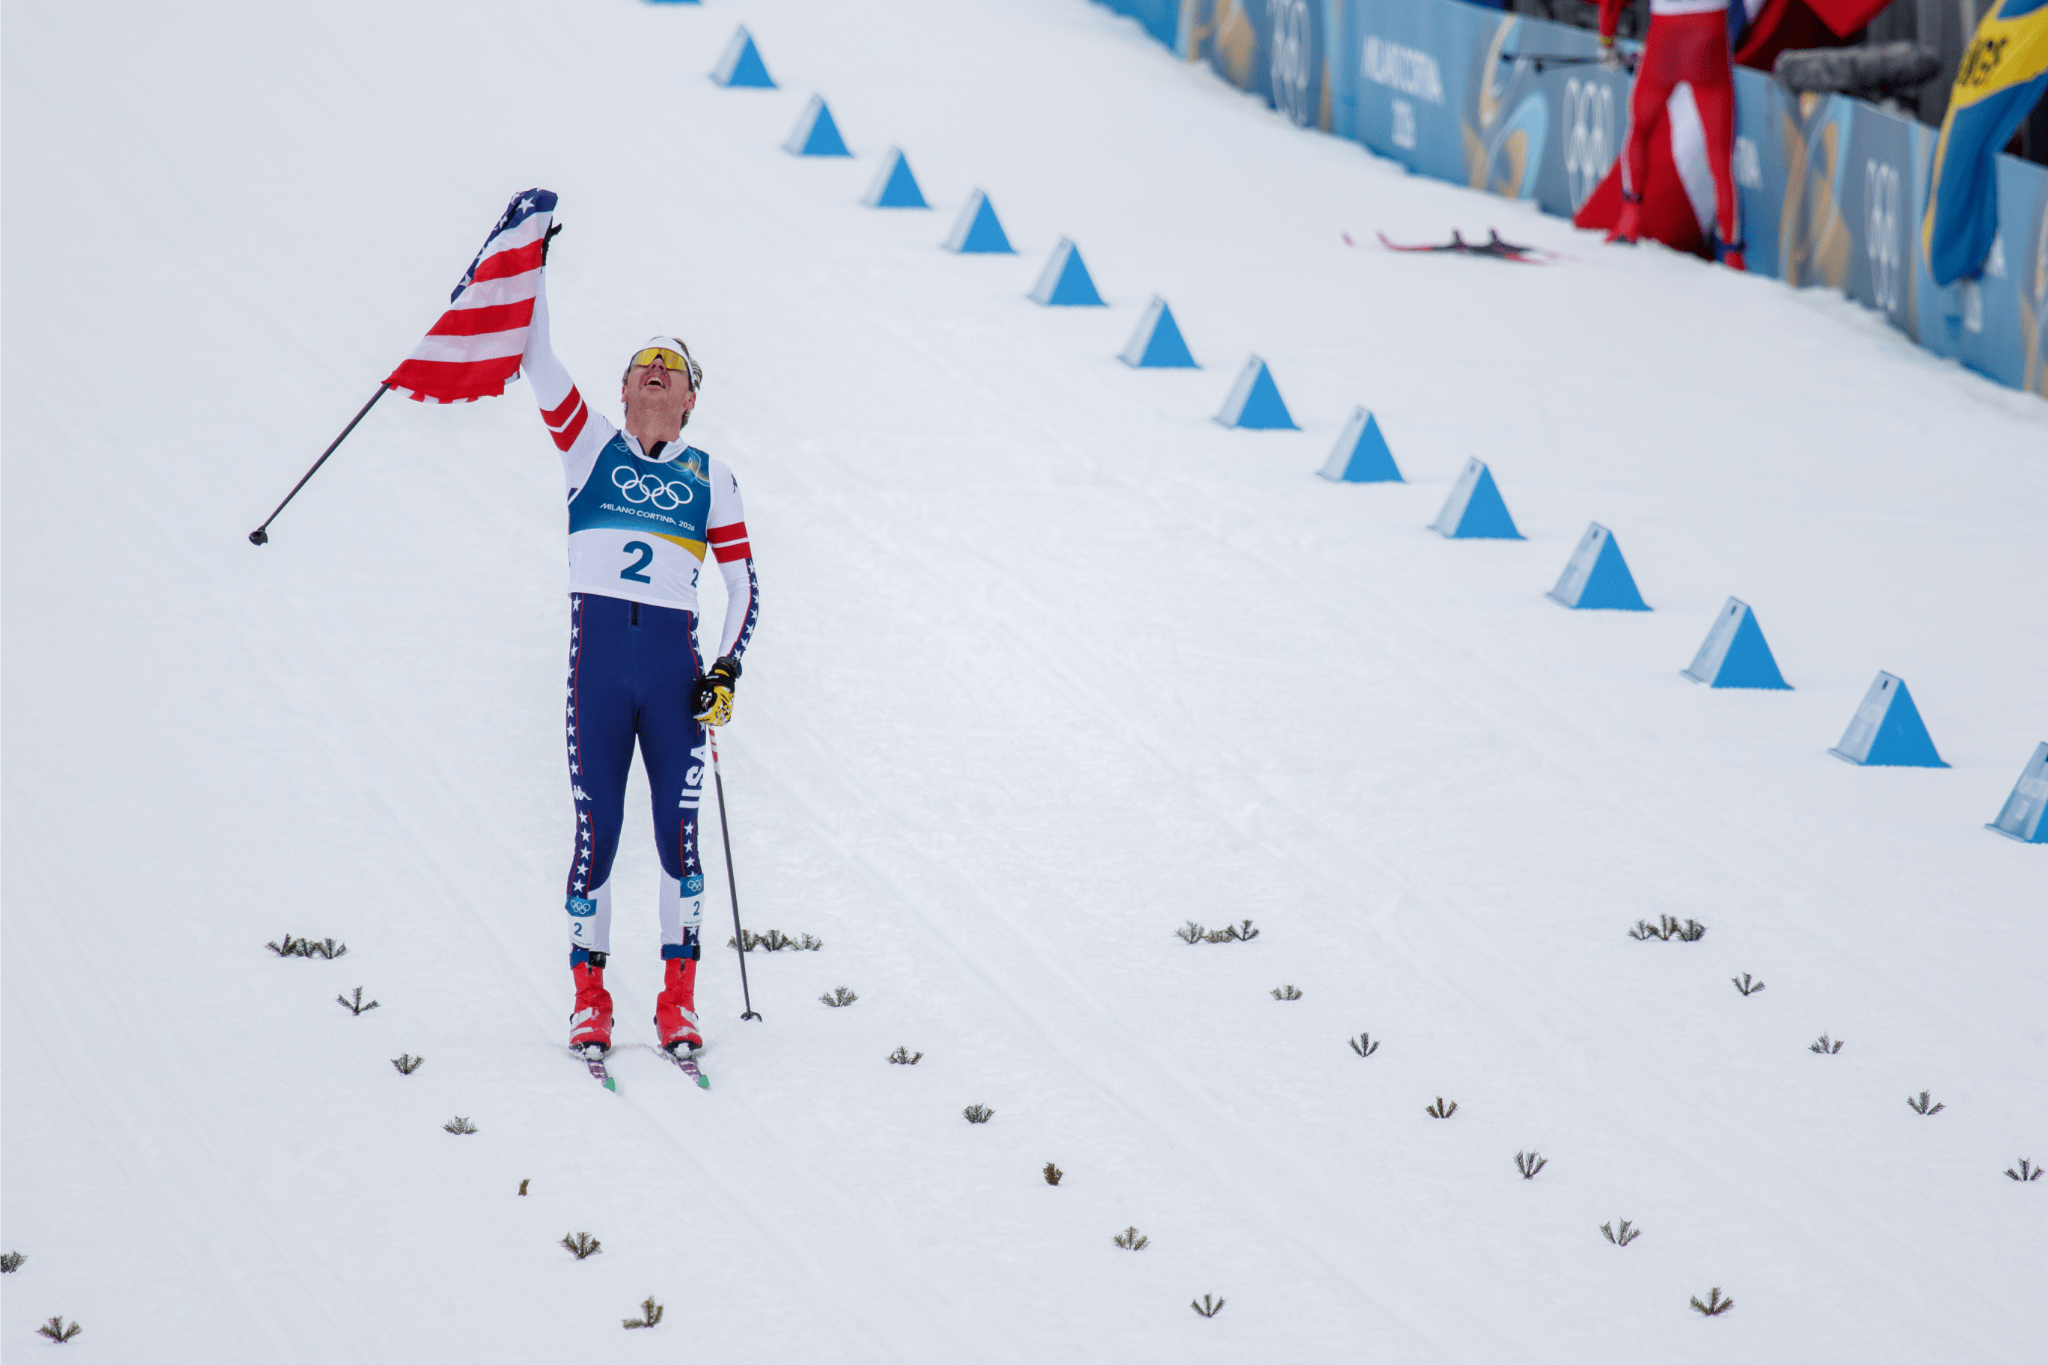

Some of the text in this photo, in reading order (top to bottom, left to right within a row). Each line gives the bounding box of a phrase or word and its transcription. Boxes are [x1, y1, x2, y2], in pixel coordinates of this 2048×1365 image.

[599, 503, 695, 532] MILANO CORTINA 2026
[620, 540, 654, 585] 2
[691, 568, 699, 588] 2
[679, 745, 706, 809] USA
[693, 900, 700, 917] 2
[573, 922, 583, 937] 2
